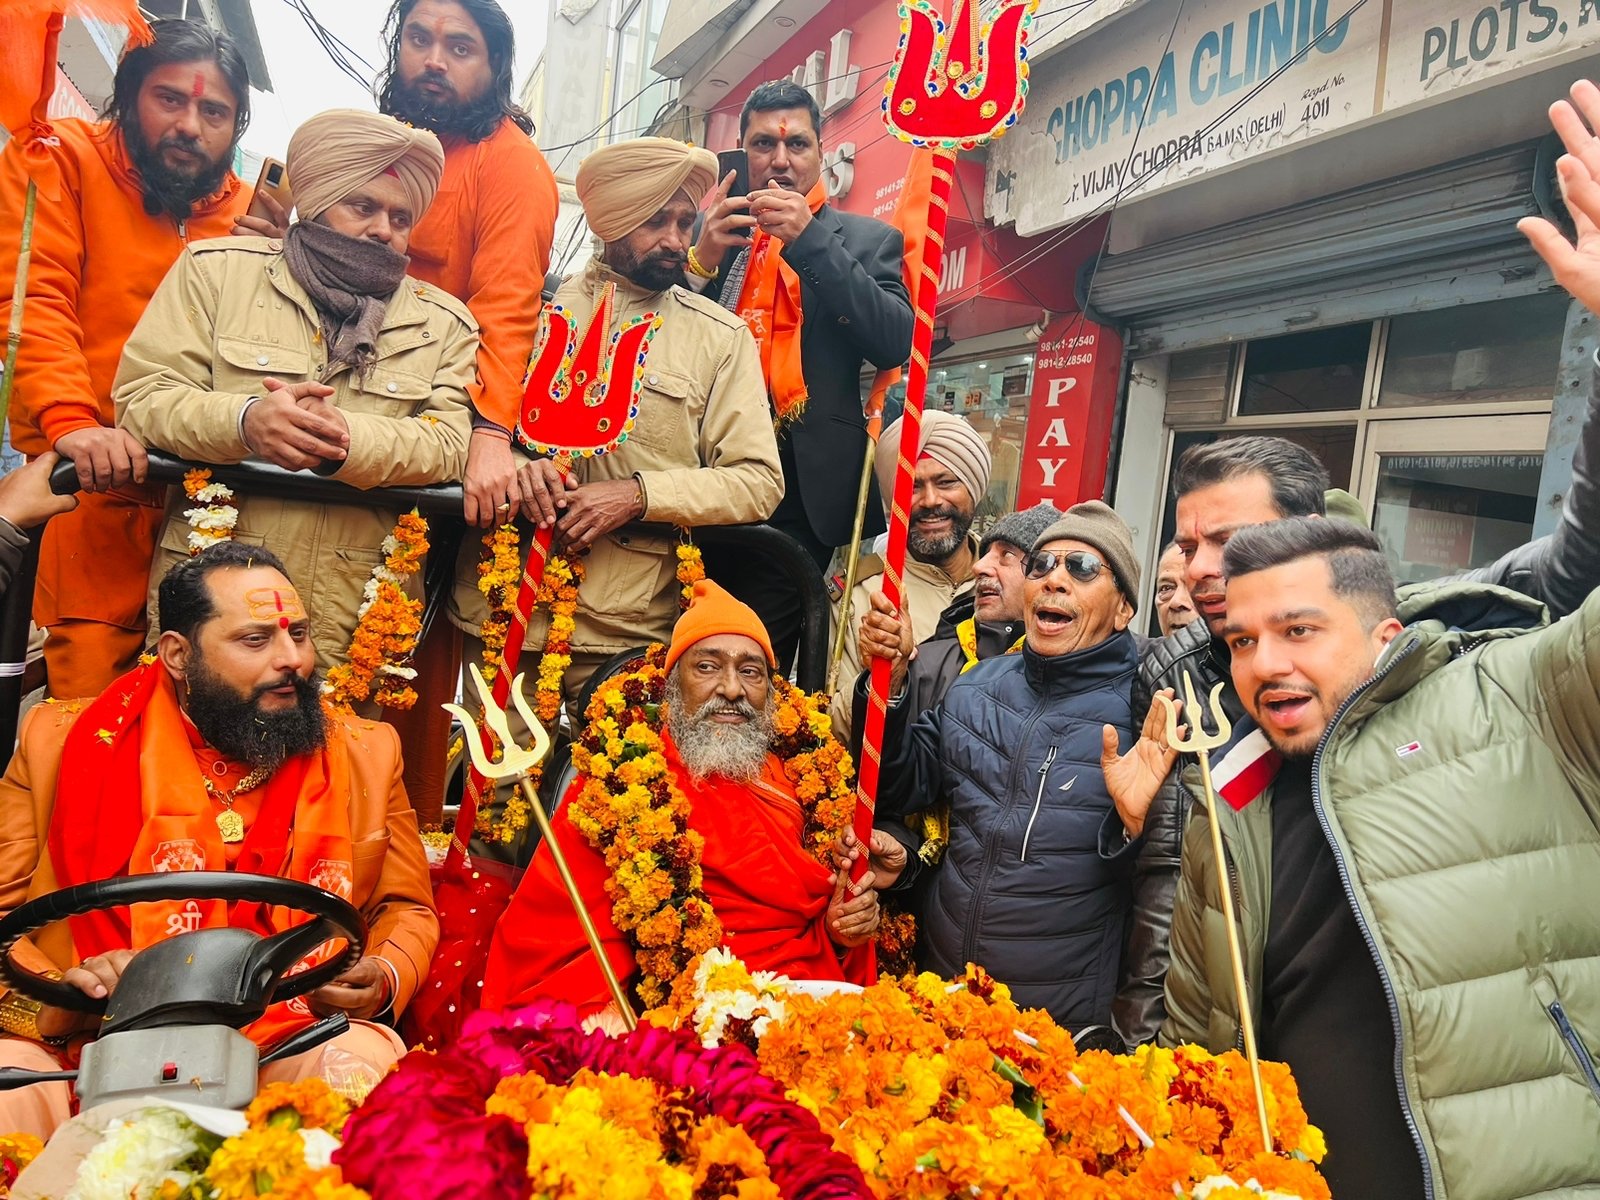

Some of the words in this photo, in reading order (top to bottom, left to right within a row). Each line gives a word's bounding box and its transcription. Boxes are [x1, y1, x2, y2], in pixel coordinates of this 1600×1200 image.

[1046, 47, 1179, 161] CHOPRA
[1189, 0, 1350, 106] CLINIC
[1300, 96, 1330, 122] 4011
[1083, 158, 1126, 198] VIJAY
[1130, 130, 1203, 179] CHOPRA
[1037, 377, 1077, 508] PAY
